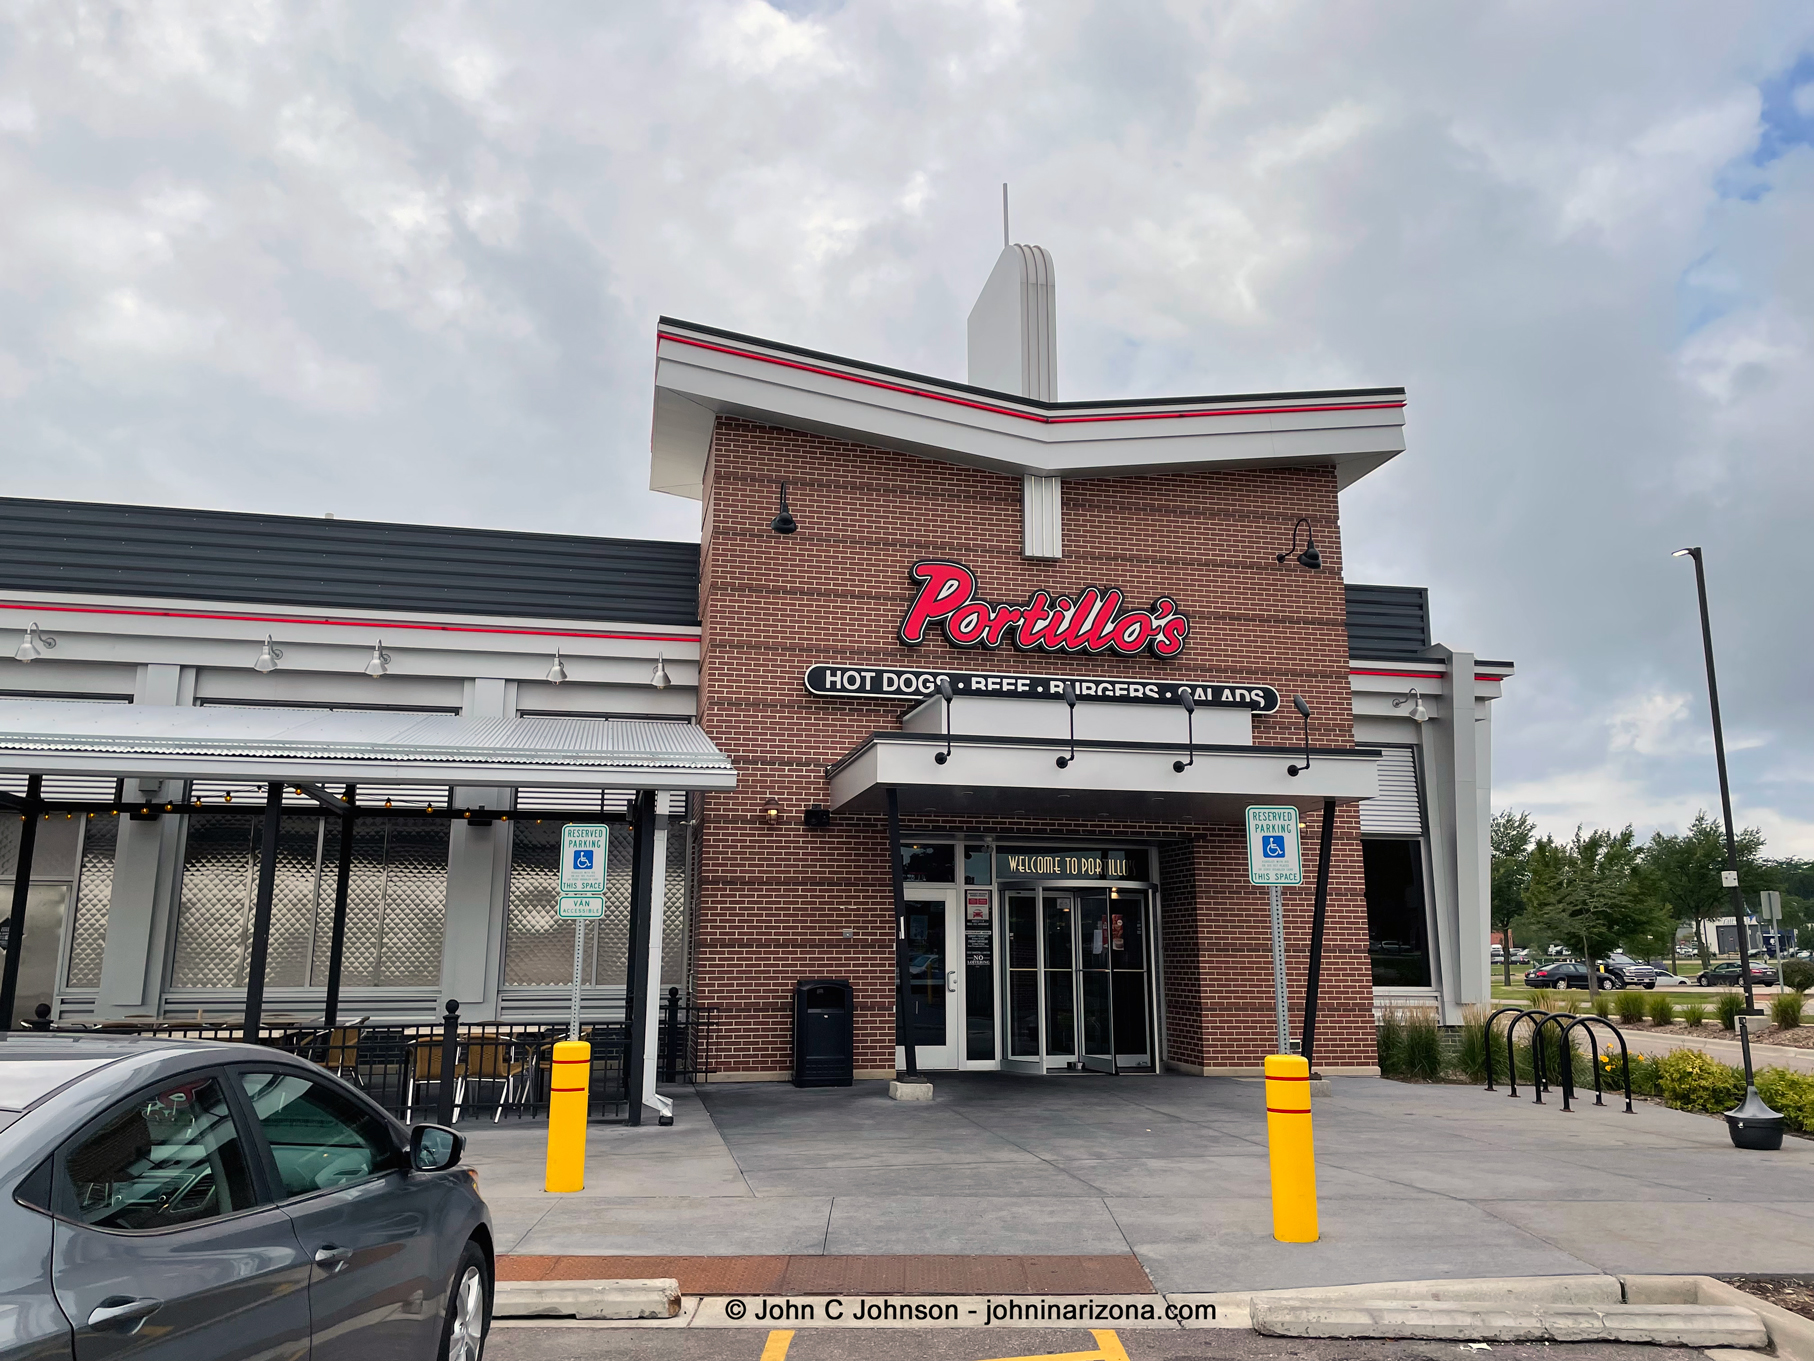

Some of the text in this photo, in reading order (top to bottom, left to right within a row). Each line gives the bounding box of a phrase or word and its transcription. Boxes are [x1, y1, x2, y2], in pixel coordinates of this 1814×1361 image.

[901, 560, 1190, 658] Portillo's
[825, 670, 875, 690] HOT
[1252, 811, 1293, 822] RESERVED
[567, 829, 603, 838] RESERVED
[1254, 823, 1292, 834] PARKING
[568, 839, 601, 848] PARKING
[1008, 855, 1061, 874] WELCOME
[1065, 857, 1078, 875] TO
[1254, 872, 1298, 881] THIS SPACE
